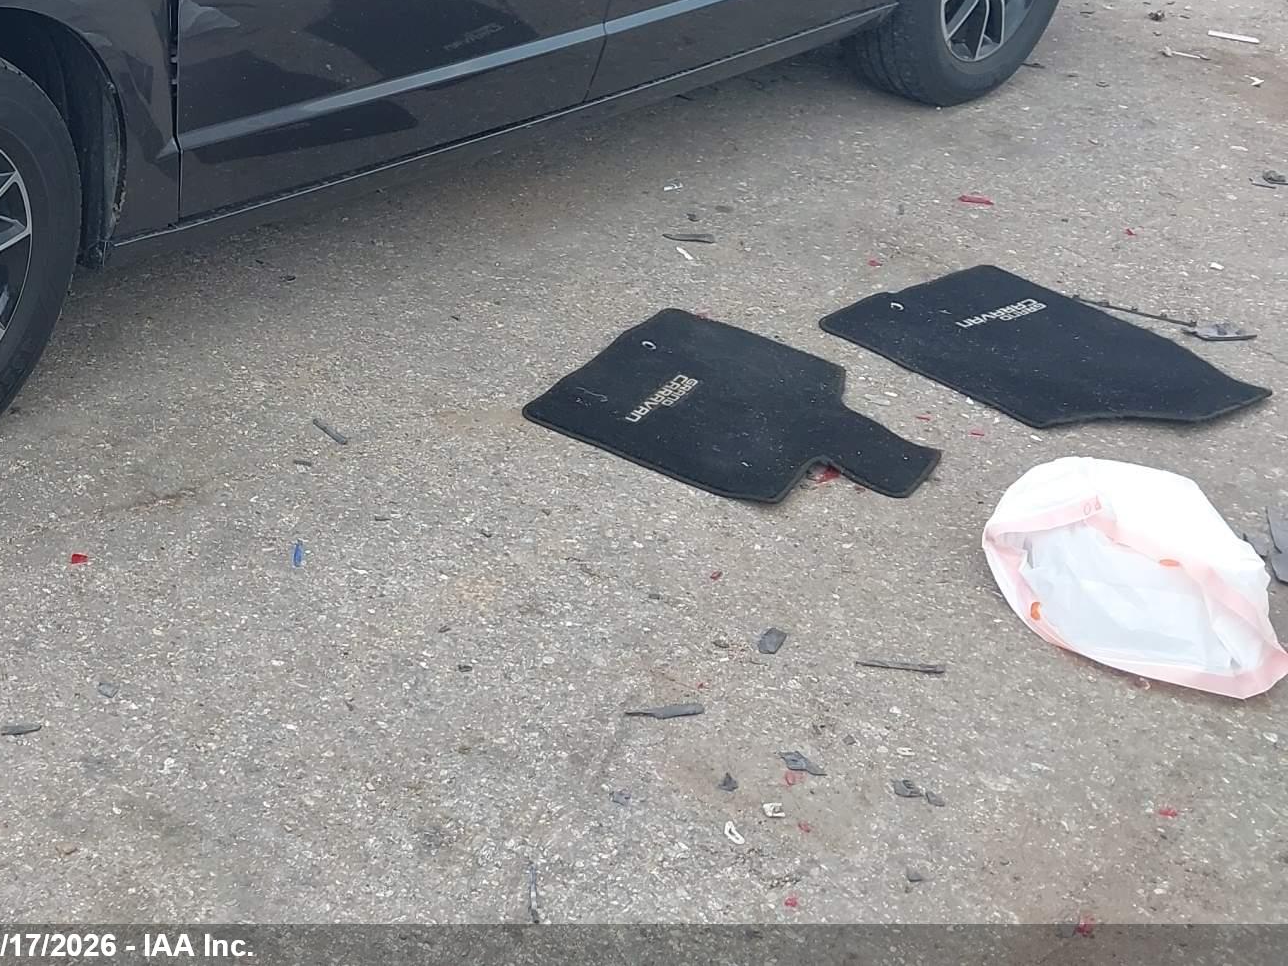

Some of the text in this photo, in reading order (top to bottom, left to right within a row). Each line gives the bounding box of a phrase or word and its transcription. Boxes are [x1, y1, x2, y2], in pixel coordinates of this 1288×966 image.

[955, 298, 1038, 328] CARAVAN
[999, 302, 1047, 321] GRAND
[625, 374, 689, 422] CARAVAN
[661, 378, 699, 407] GRAND
